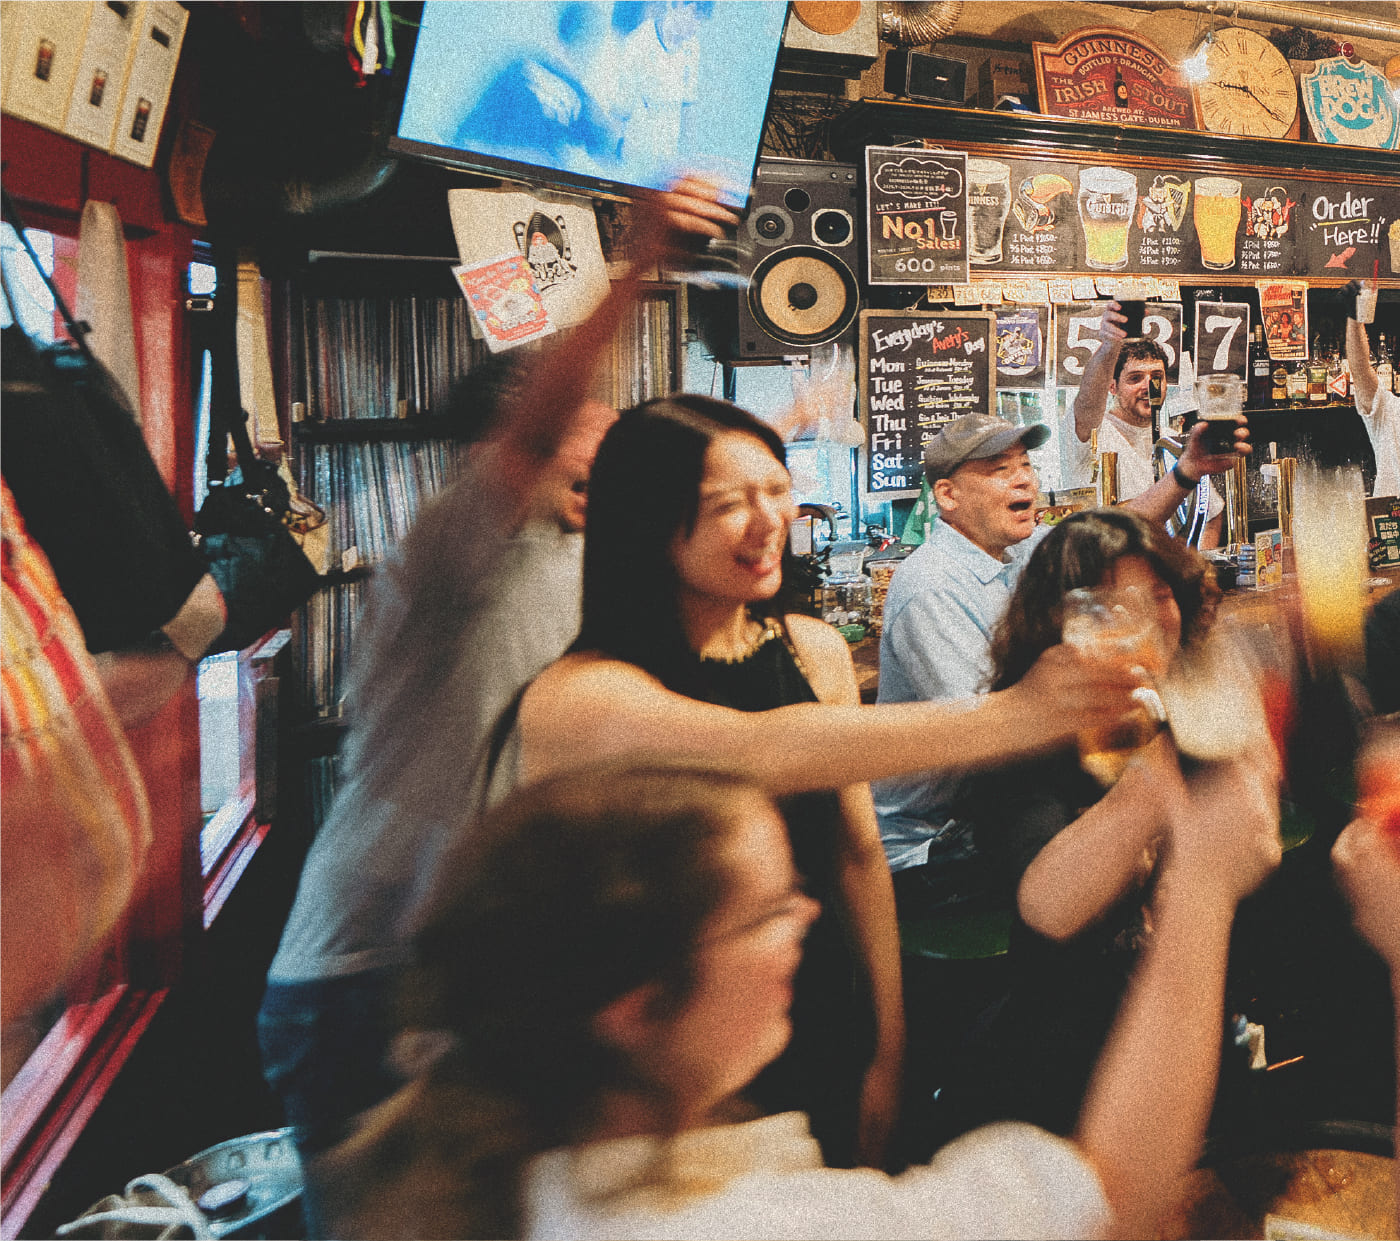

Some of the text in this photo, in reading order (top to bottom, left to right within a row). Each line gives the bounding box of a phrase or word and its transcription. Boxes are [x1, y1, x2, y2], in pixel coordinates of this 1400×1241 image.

[1063, 40, 1166, 76] GUINNESS
[1078, 56, 1111, 76] BOTTLED
[1120, 57, 1158, 83] DRAUGHT
[1051, 76, 1074, 86] THE
[1318, 74, 1374, 99] BREW
[1054, 79, 1108, 103] IRISH
[1131, 82, 1189, 115] STOUT
[1102, 105, 1134, 113] BREWED
[1321, 96, 1375, 121] DOG
[1311, 191, 1375, 221] Order
[916, 236, 962, 250] Sales!
[895, 257, 961, 273] 600 pints
[872, 321, 945, 353] Everyday's
[932, 326, 970, 354] Avery's
[1205, 315, 1243, 371] 7
